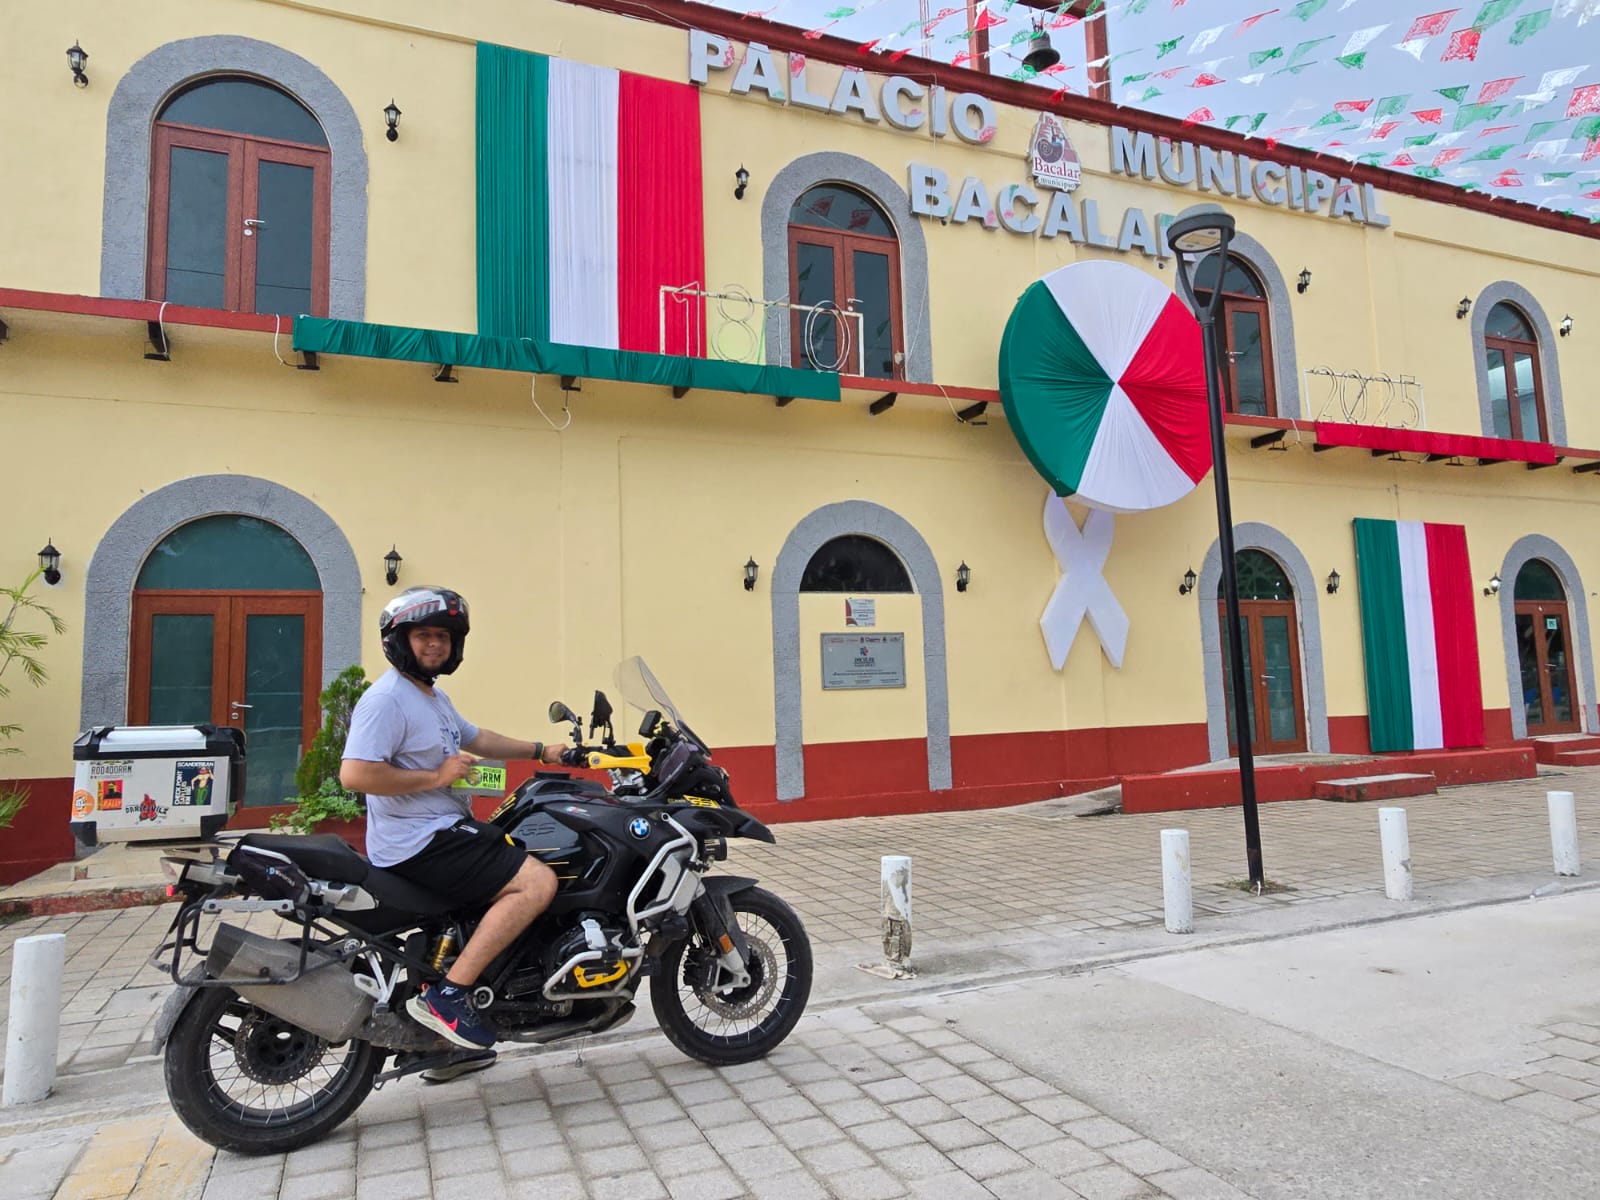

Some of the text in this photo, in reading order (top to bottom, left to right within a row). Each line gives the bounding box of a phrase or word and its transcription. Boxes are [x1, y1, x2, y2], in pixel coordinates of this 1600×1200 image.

[689, 28, 1391, 228] PALACIO MUNICIPAL
[1034, 157, 1080, 179] Bacalar
[1040, 177, 1076, 190] municipio
[671, 281, 850, 373] 1810
[1313, 365, 1420, 428] 2025
[483, 772, 501, 784] RRM
